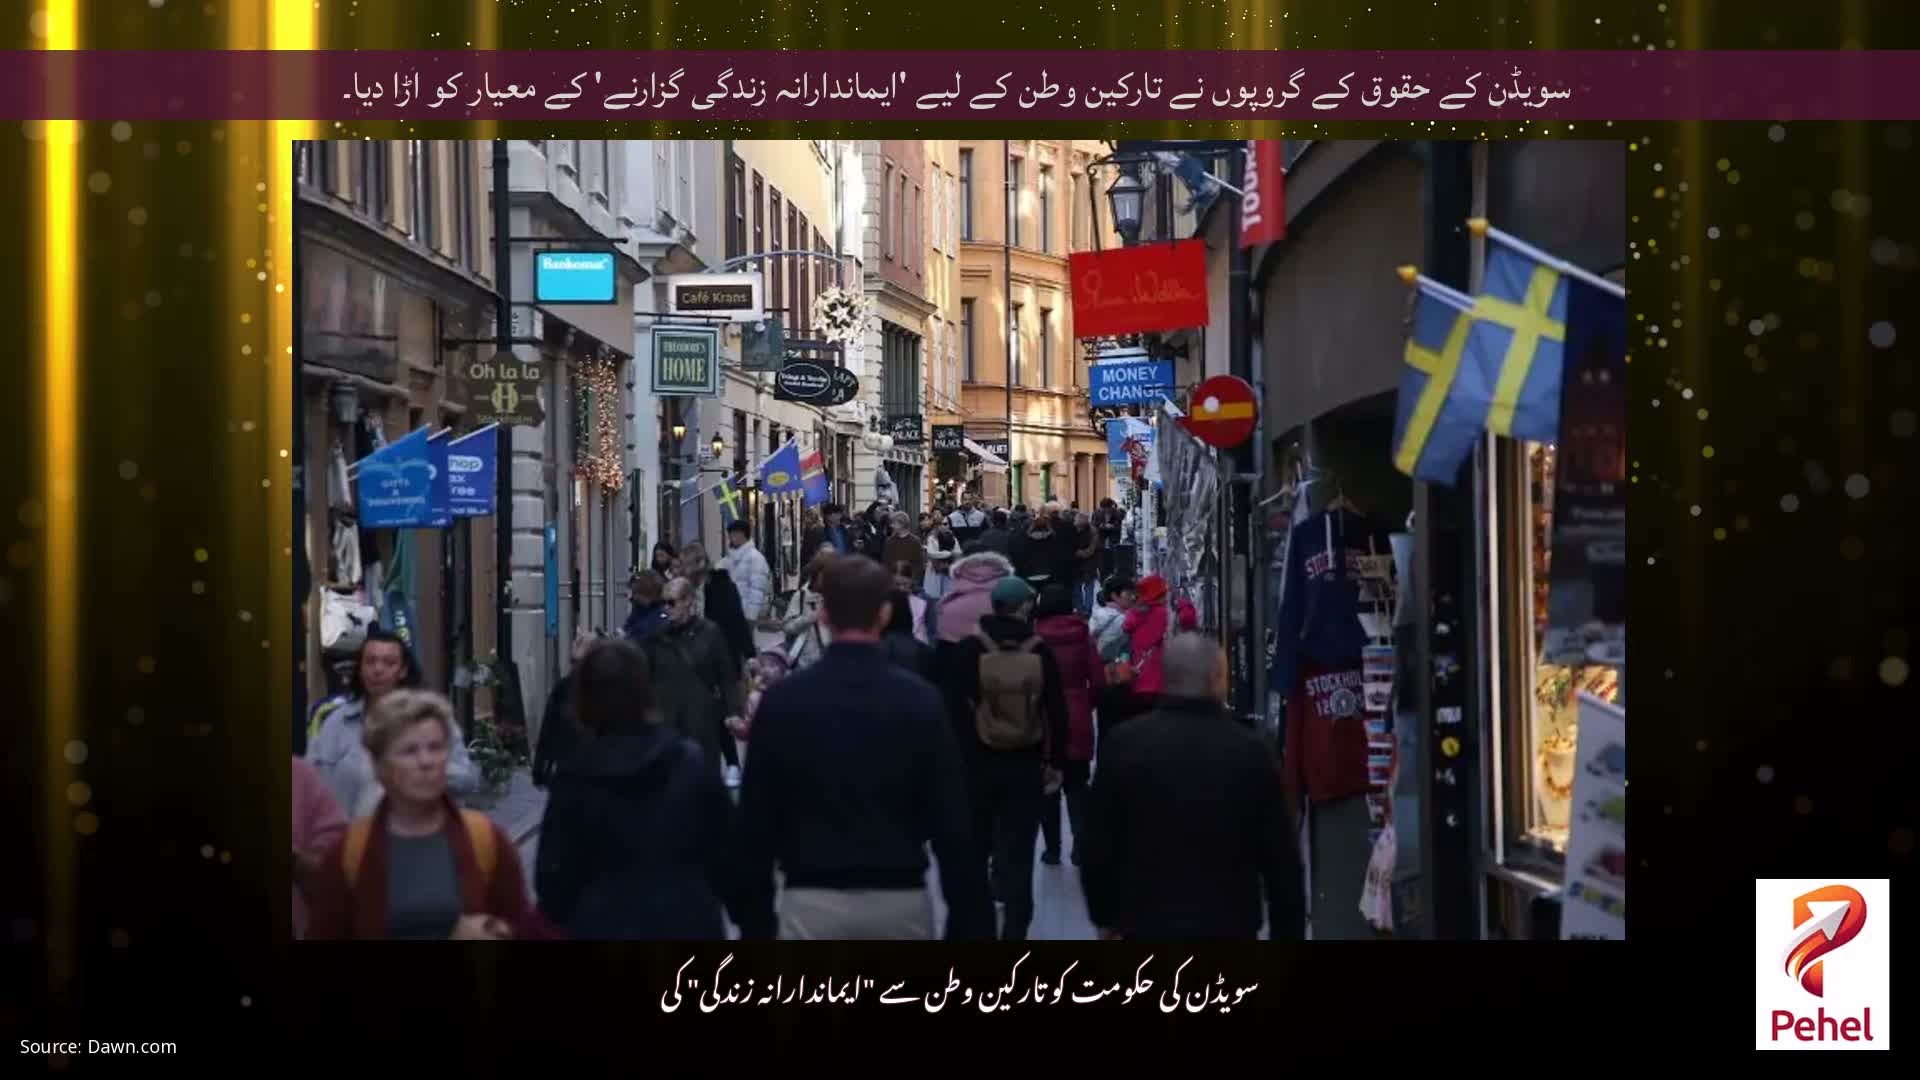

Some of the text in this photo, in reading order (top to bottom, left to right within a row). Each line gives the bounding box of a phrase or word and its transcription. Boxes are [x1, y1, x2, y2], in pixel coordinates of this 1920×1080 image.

[682, 290, 711, 304] Café
[469, 363, 496, 380] Oh
[663, 357, 706, 382] HOME
[1103, 366, 1158, 383] MONEY
[1098, 383, 1165, 400] CHANGE
